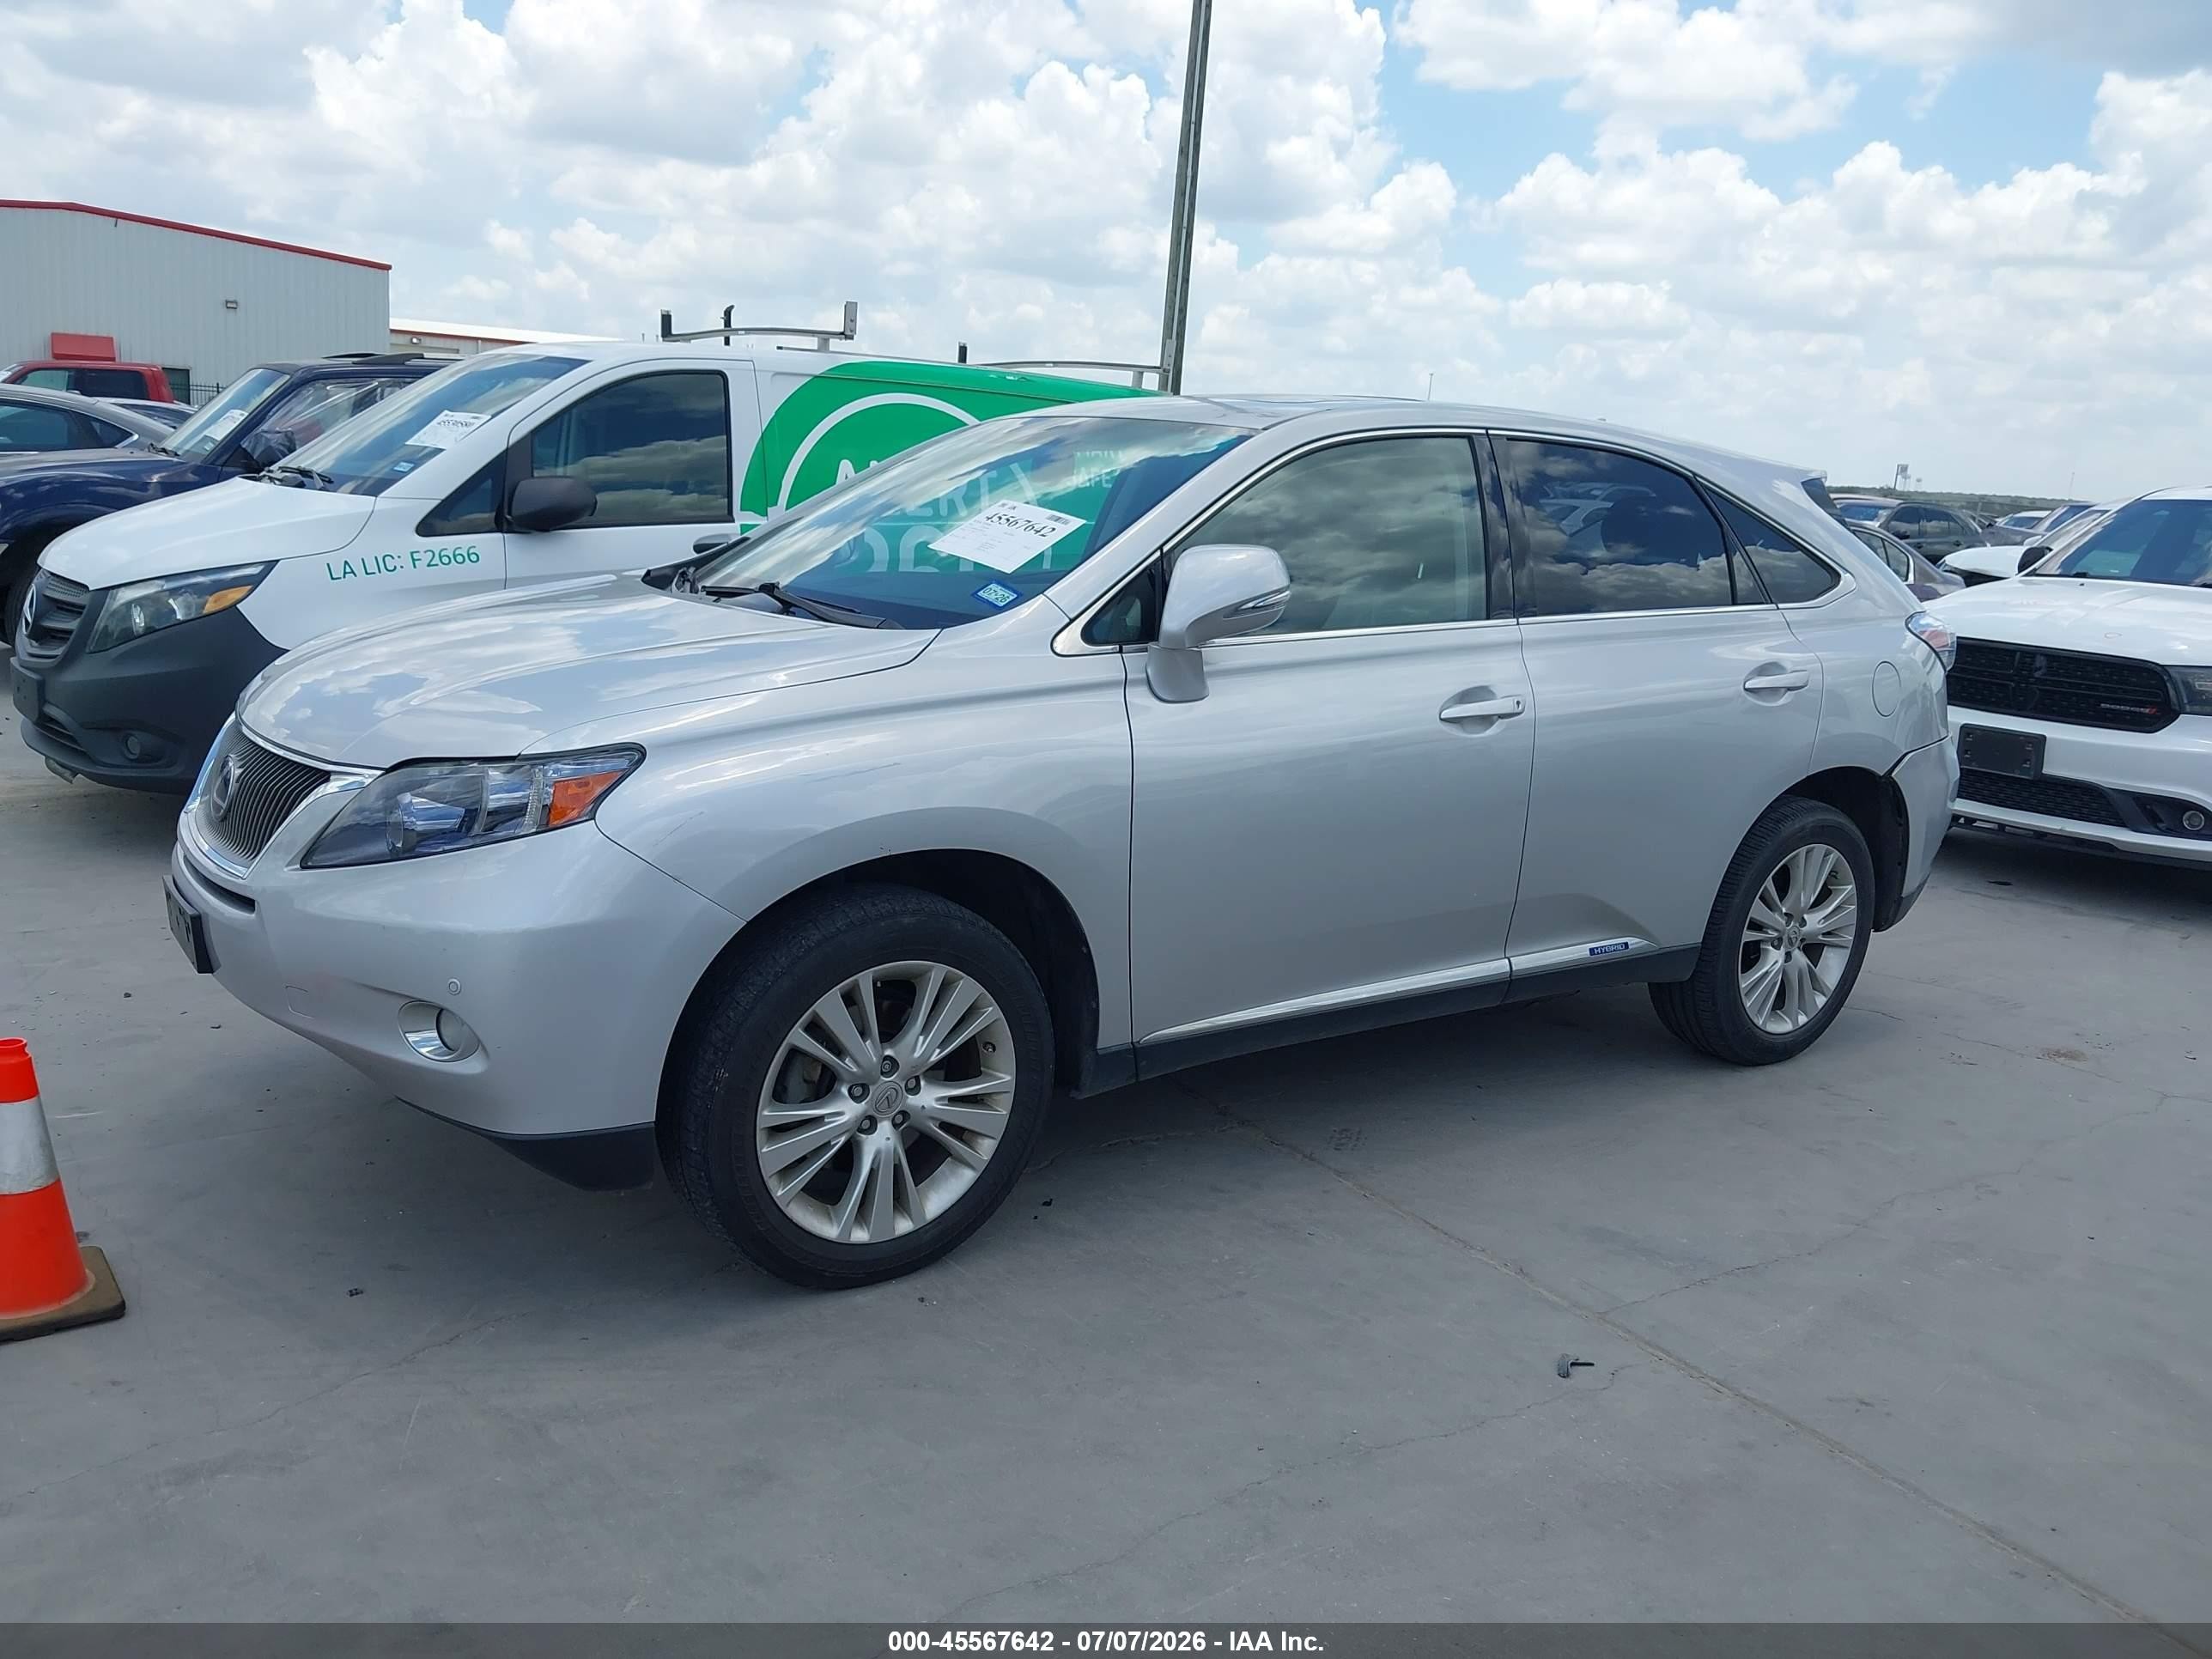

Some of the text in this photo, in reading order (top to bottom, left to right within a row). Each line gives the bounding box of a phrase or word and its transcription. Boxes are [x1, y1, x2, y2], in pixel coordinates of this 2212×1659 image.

[985, 512, 1057, 538] 45567642
[326, 545, 480, 580] LA LIC: F2666
[1594, 943, 1626, 955] HYBRID
